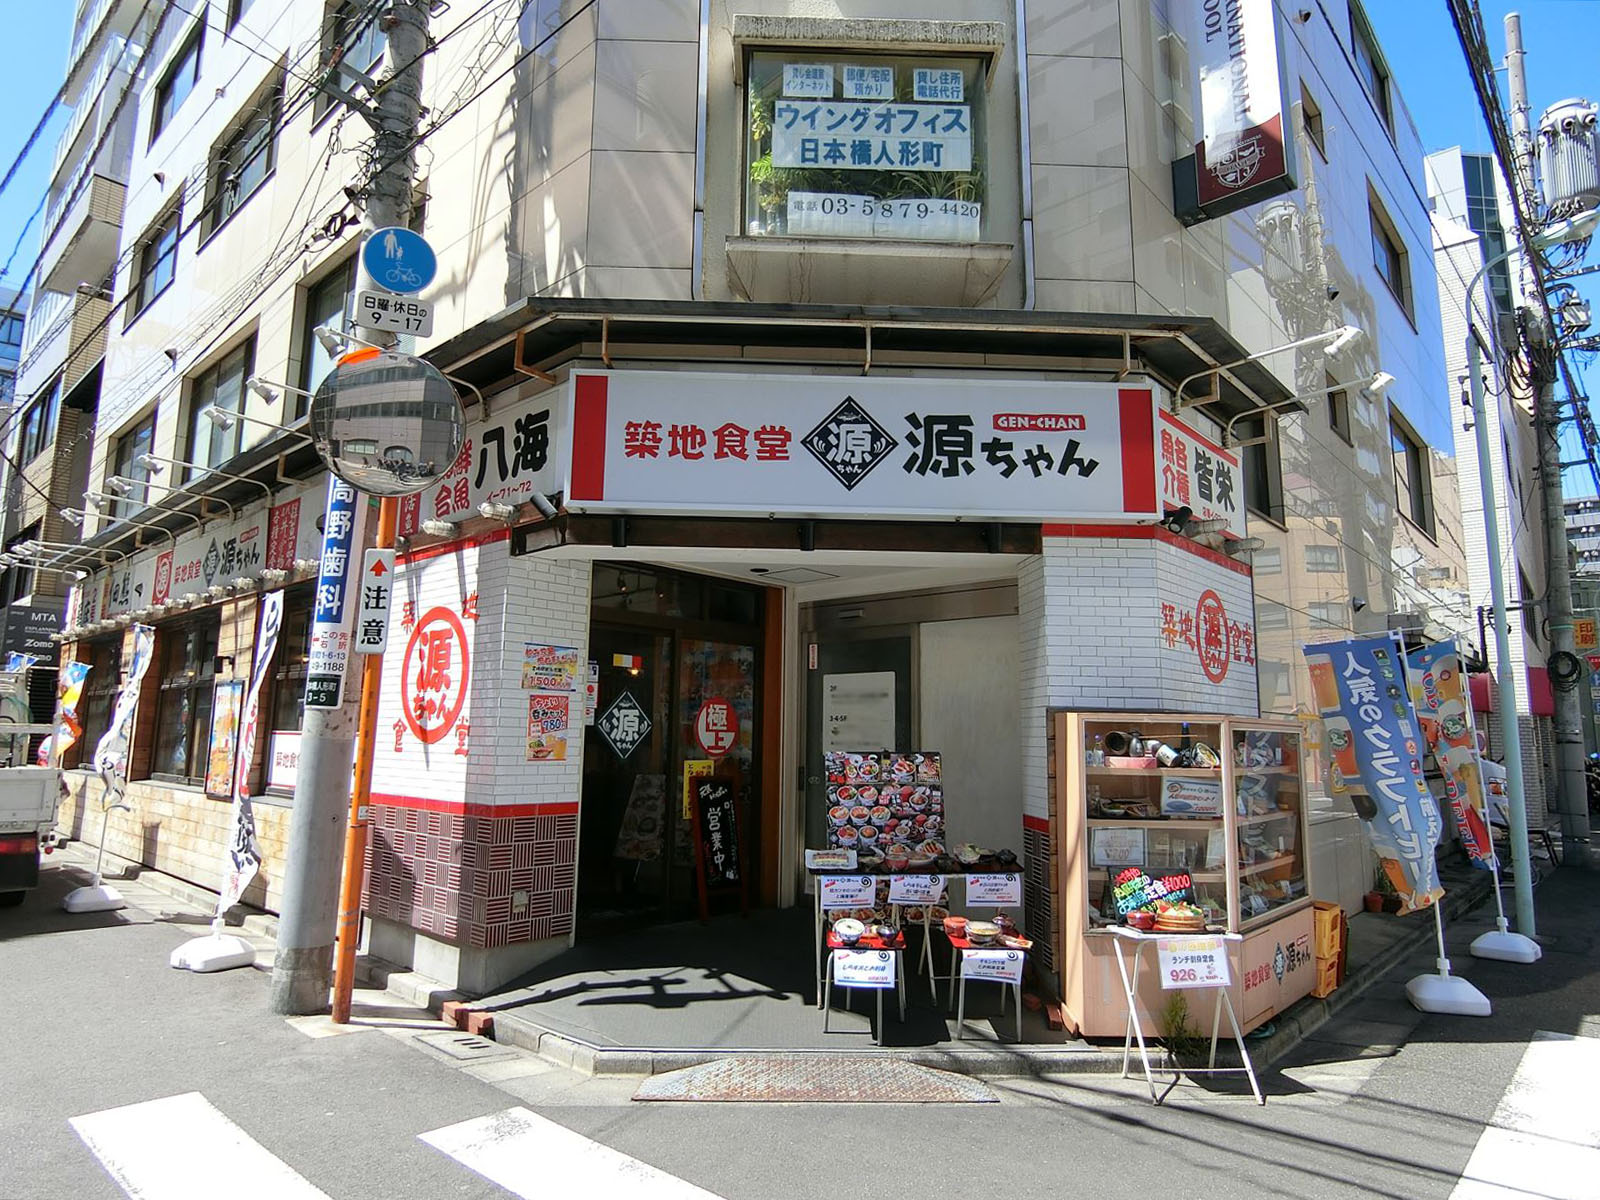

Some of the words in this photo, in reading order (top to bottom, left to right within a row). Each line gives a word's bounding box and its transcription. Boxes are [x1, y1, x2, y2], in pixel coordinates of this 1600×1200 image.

[846, 68, 890, 83] 郵便/宅配
[916, 71, 961, 84] 貸し住所
[785, 80, 832, 91] インターネット
[853, 82, 883, 96] 預かり
[916, 84, 961, 98] 電話代行
[777, 104, 968, 134] ウイングオフィス
[800, 138, 944, 167] 日本橋人形町
[792, 200, 818, 213] 電話
[998, 416, 1080, 430] GEN-CHAN
[624, 420, 792, 461] 築地食堂
[822, 421, 874, 465] 源
[902, 412, 1100, 478] 源ちゃん
[475, 409, 550, 489] 八海
[836, 463, 863, 474] ちゃん
[31, 612, 57, 622] MTA
[361, 585, 389, 645] 注意
[24, 638, 54, 648] Zomo
[321, 631, 349, 642] この先
[417, 627, 453, 693] 源
[610, 707, 640, 742] 源
[707, 806, 725, 872] 営業中
[1170, 968, 1197, 982] 926
